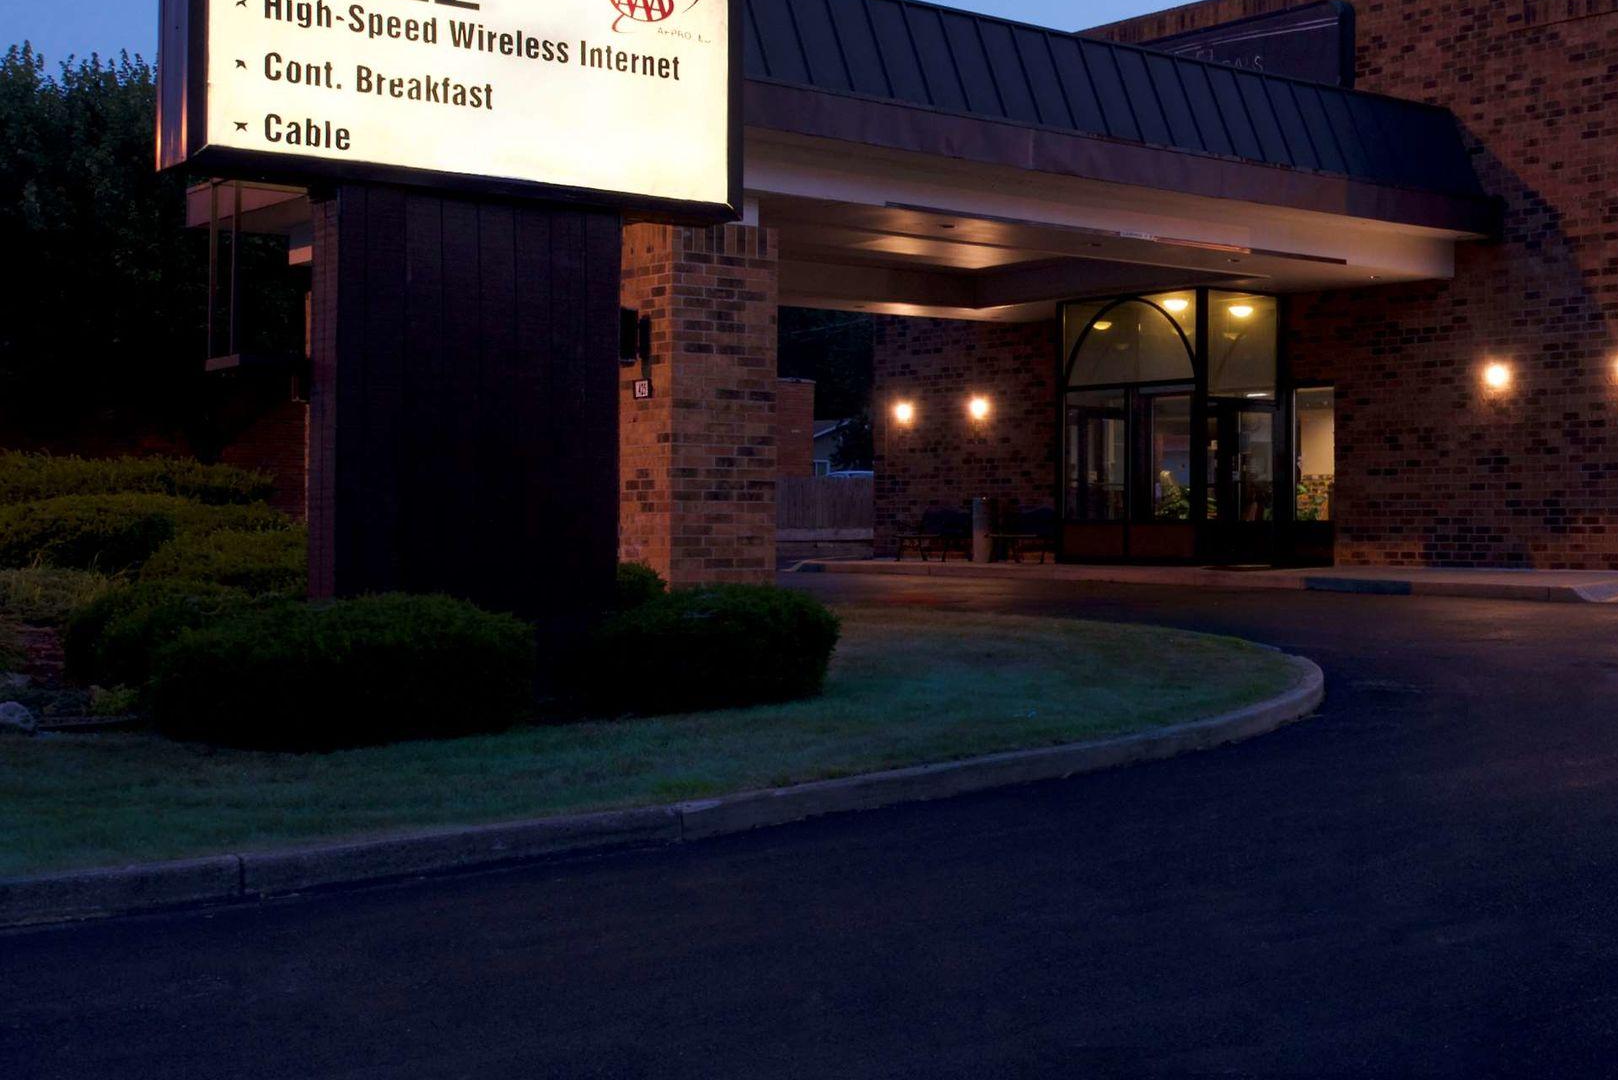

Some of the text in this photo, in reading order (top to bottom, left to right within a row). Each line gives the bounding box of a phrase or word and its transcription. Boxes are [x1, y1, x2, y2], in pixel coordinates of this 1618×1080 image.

[450, 19, 569, 65] Wireless
[580, 40, 680, 81] Internet
[264, 52, 493, 110] Cont. Breakfast
[264, 113, 351, 152] Cable
